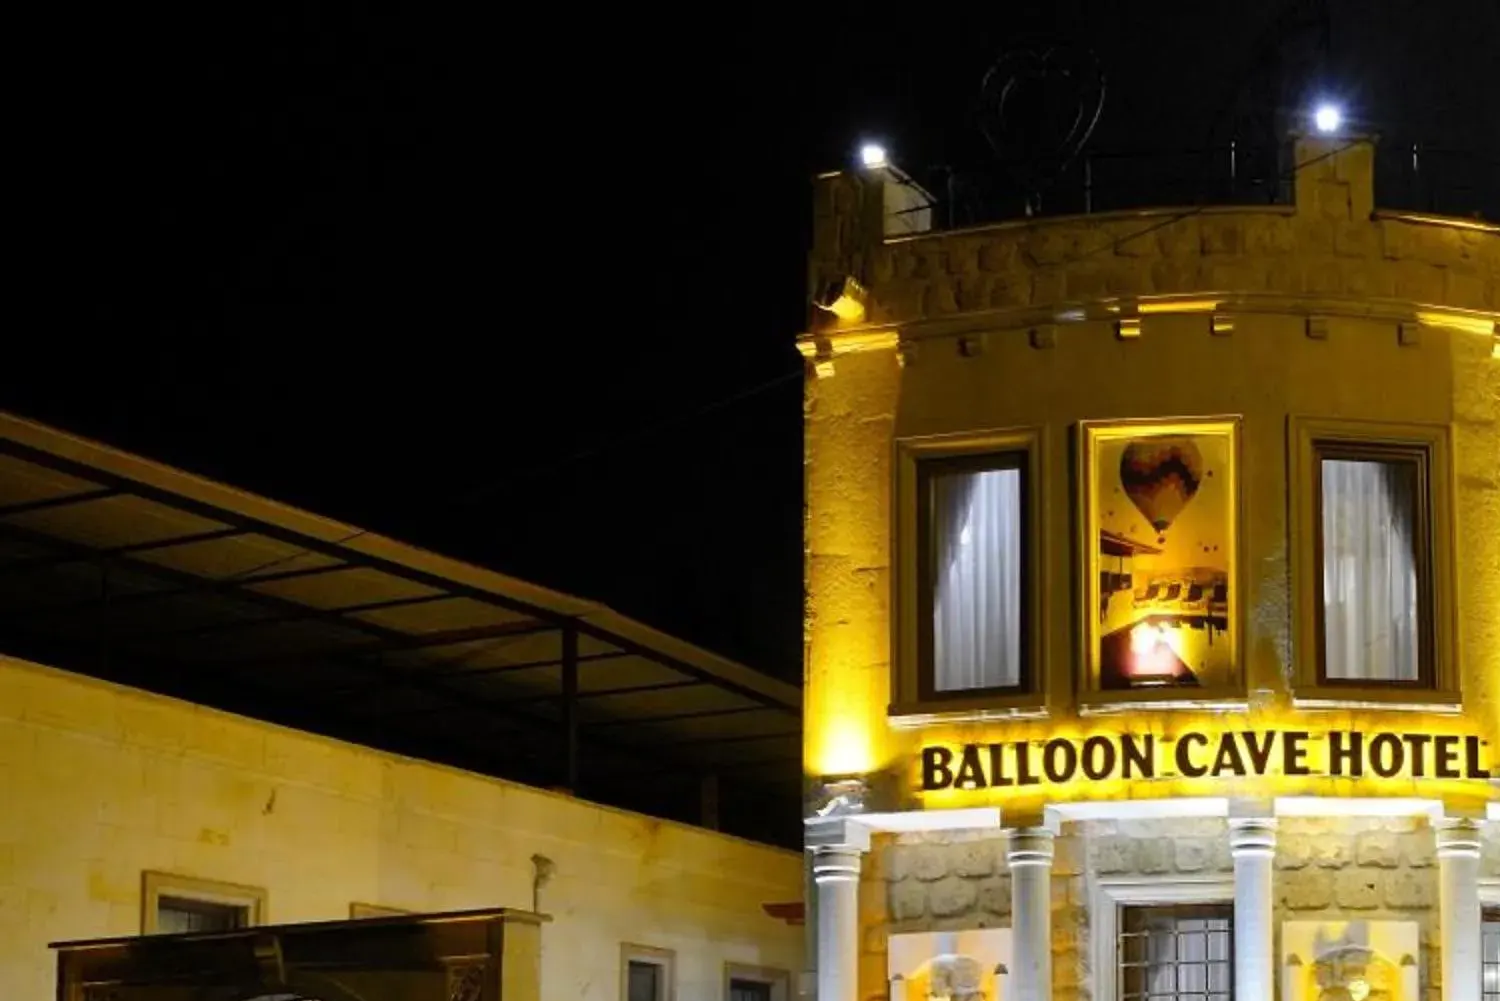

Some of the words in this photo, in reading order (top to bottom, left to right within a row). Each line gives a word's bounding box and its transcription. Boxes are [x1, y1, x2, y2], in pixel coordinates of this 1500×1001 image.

[921, 733, 1155, 791] BALLOON
[1174, 730, 1310, 778] CAVE
[1328, 731, 1491, 779] HOTEL
